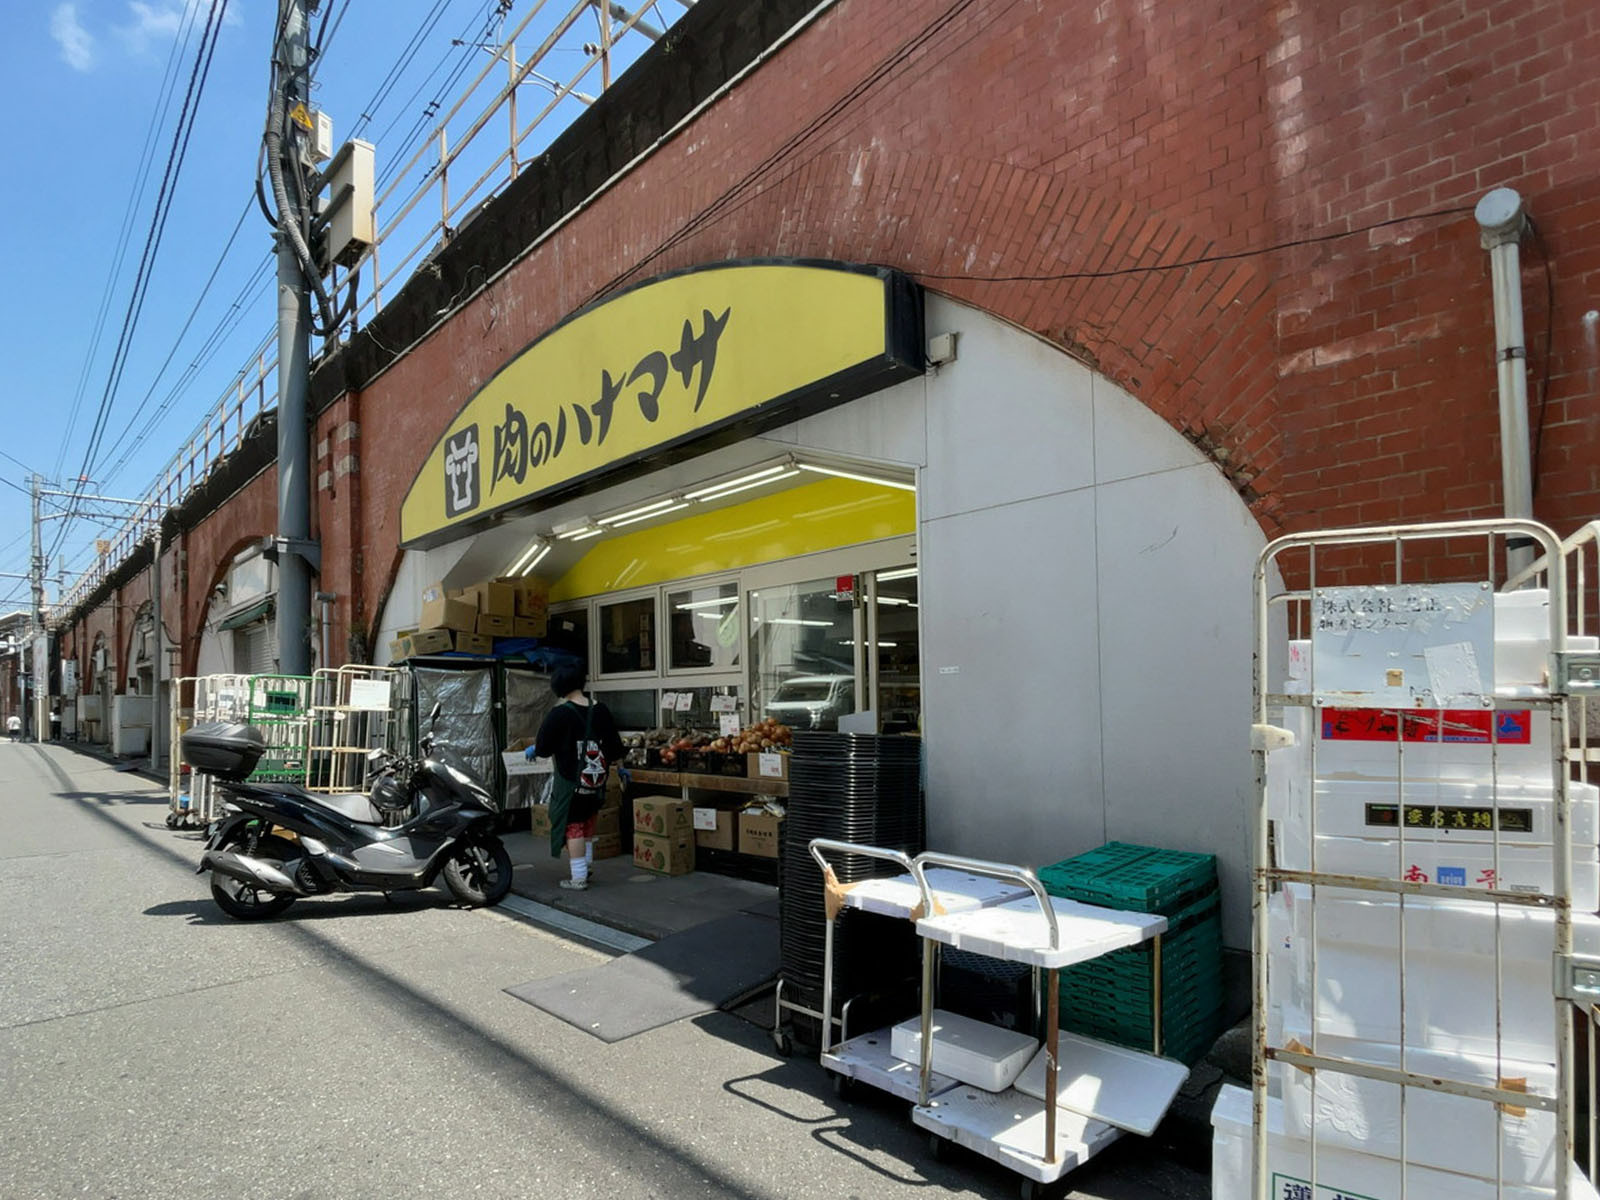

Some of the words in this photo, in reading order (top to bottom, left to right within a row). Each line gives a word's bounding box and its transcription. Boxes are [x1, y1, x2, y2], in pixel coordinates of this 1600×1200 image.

[490, 306, 732, 497] 肉のハナマサ
